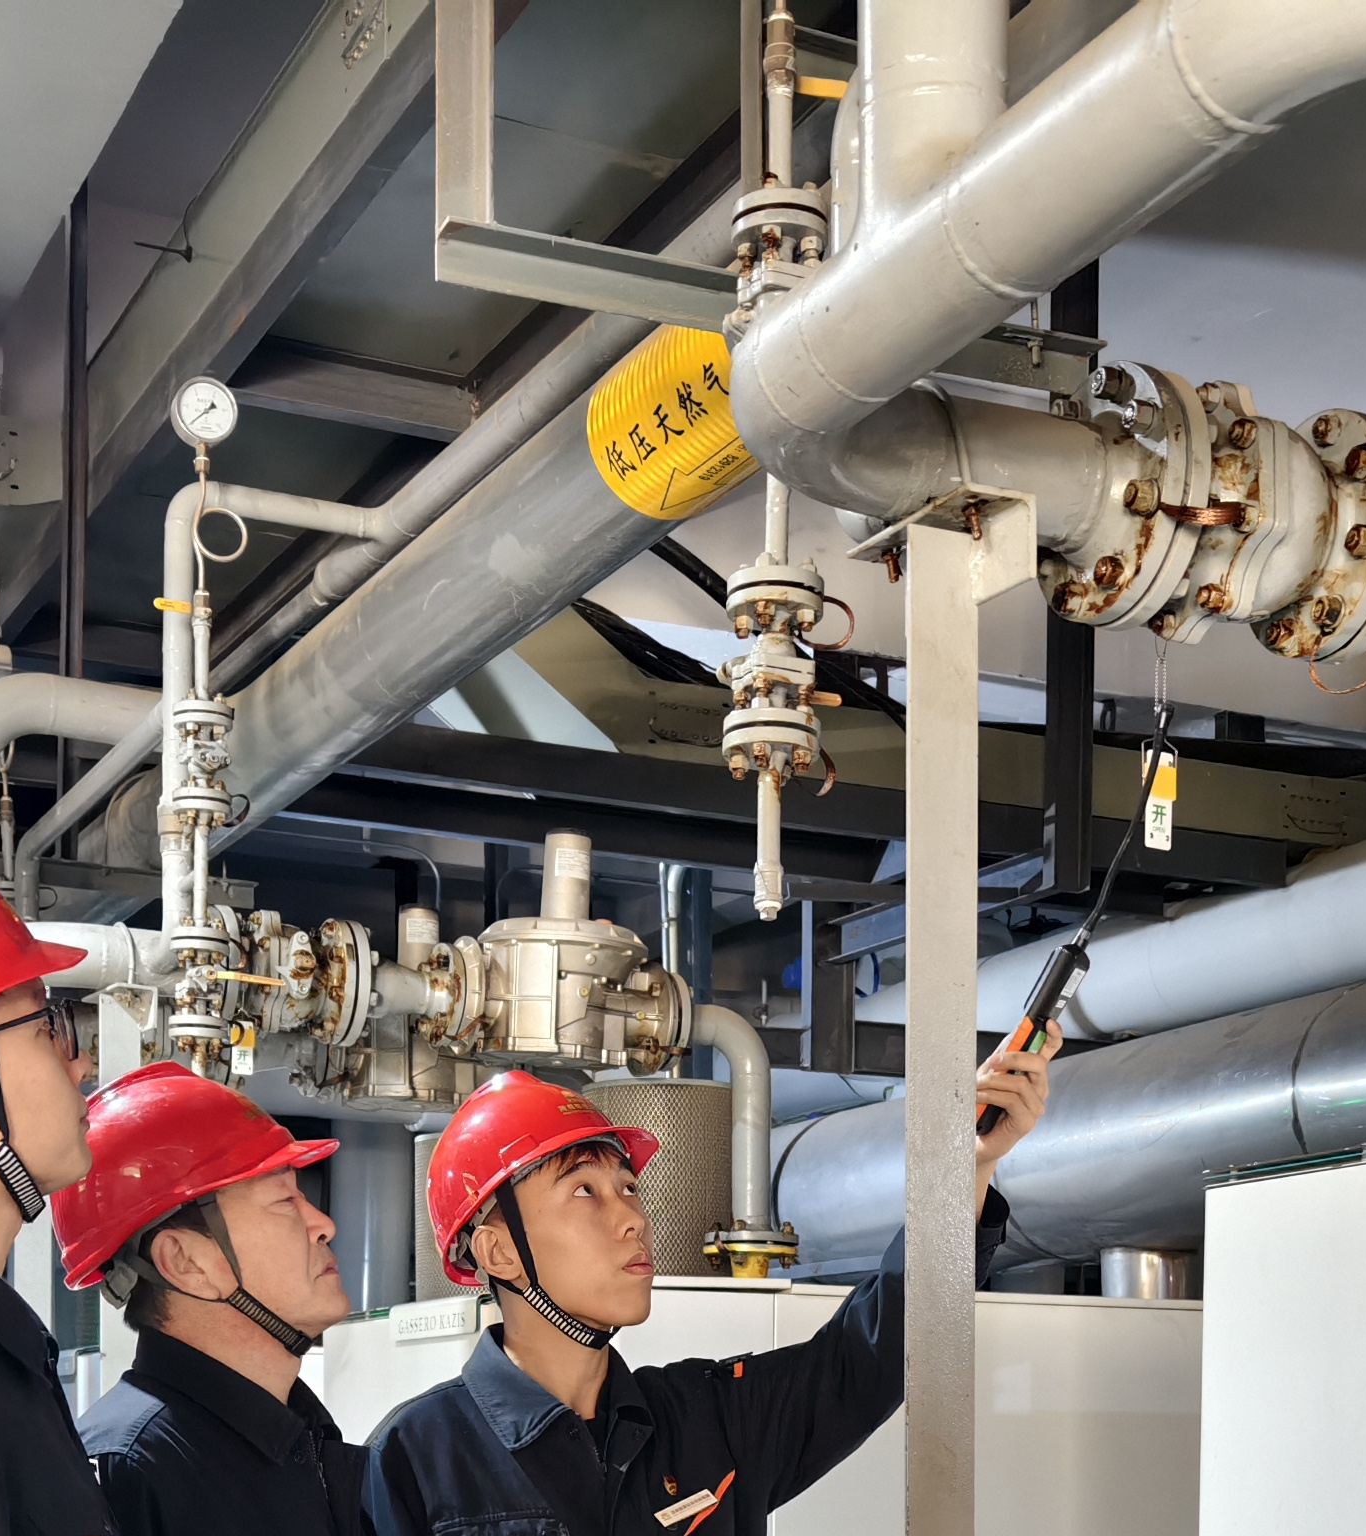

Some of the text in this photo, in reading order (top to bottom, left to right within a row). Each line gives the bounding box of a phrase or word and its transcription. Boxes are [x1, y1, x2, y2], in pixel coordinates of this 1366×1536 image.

[605, 362, 730, 481] 低压天然气
[1152, 804, 1167, 825] 开
[236, 1049, 249, 1062] 开
[439, 1311, 466, 1330] KAZIS
